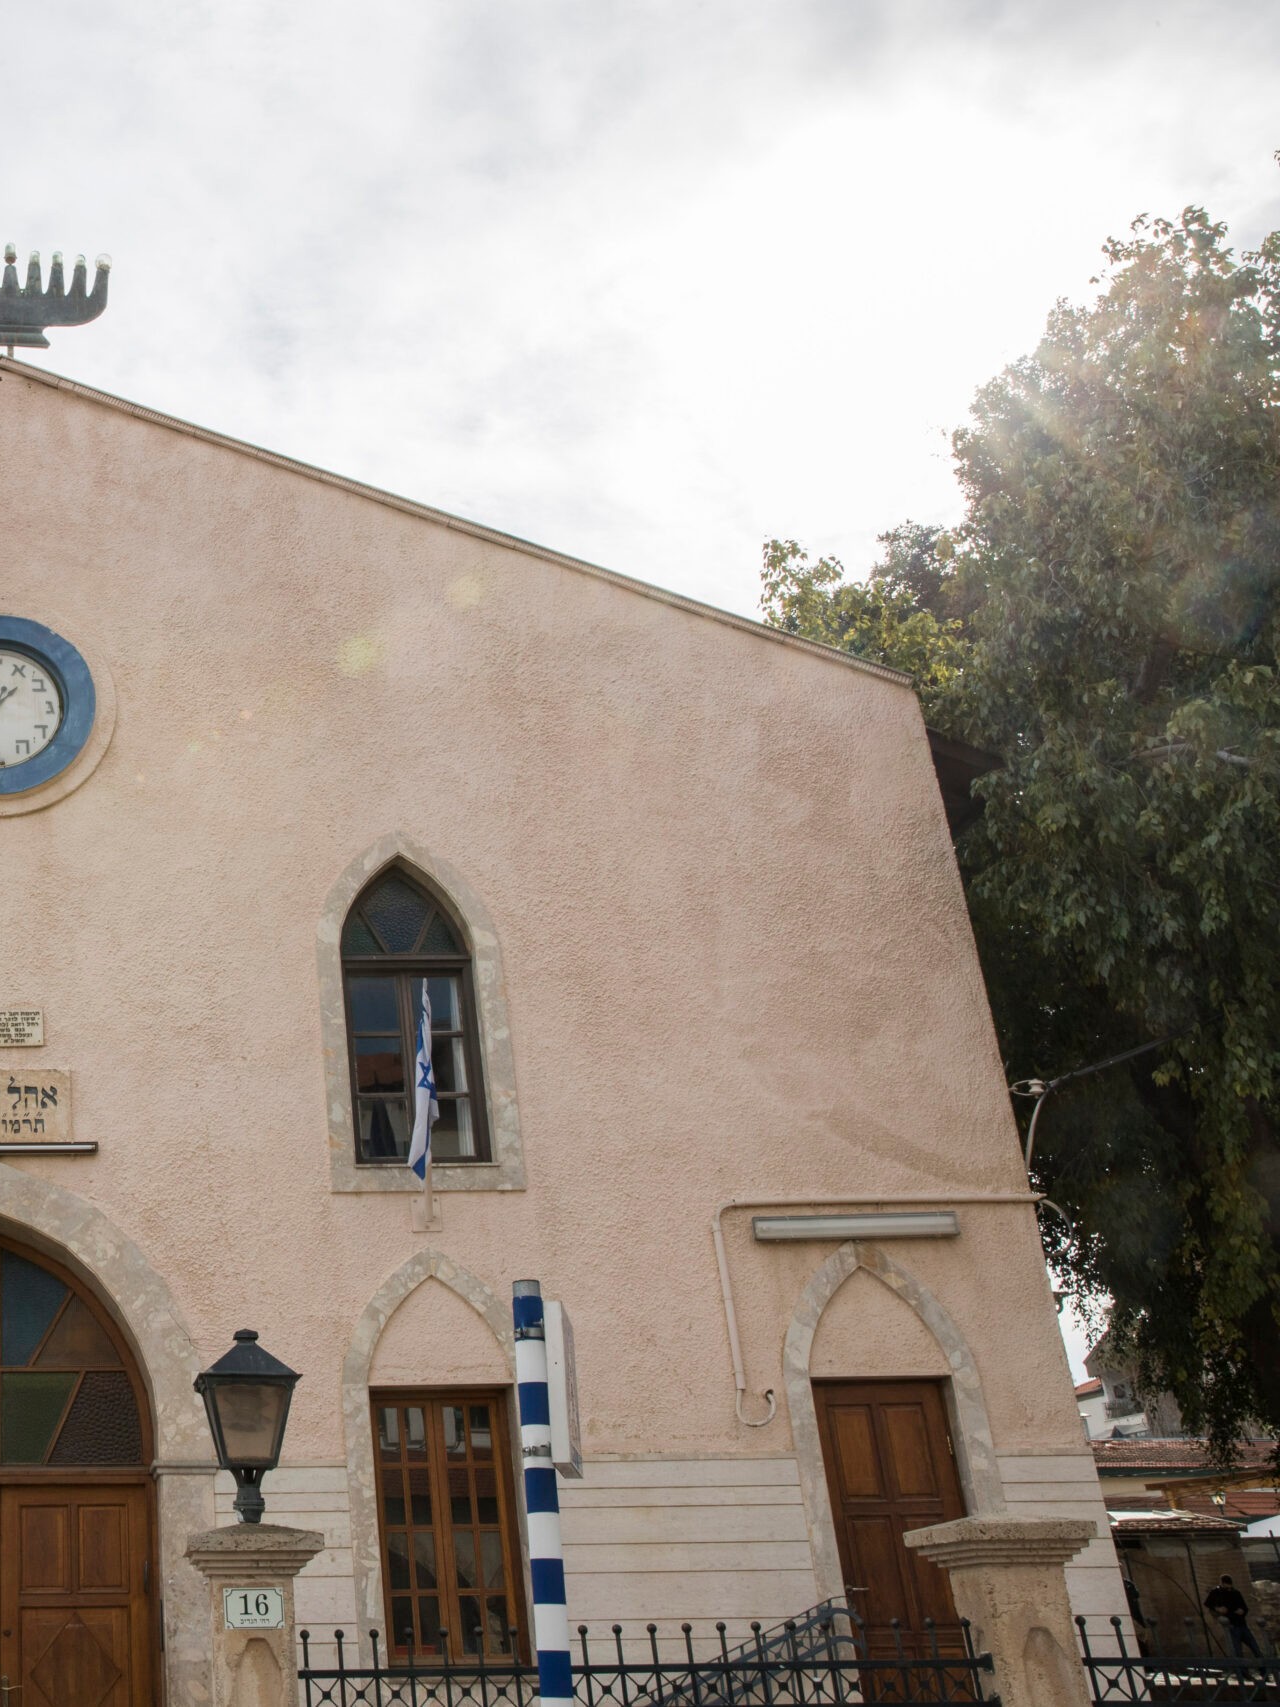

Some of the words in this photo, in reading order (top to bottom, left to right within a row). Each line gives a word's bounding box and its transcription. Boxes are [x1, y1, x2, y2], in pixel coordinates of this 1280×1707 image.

[11, 664, 26, 678] א
[32, 679, 47, 692] ב
[45, 701, 55, 714] ג
[33, 725, 48, 739] ד
[15, 740, 30, 754] ה
[7, 1076, 58, 1111] אהל
[239, 1593, 269, 1616] 16
